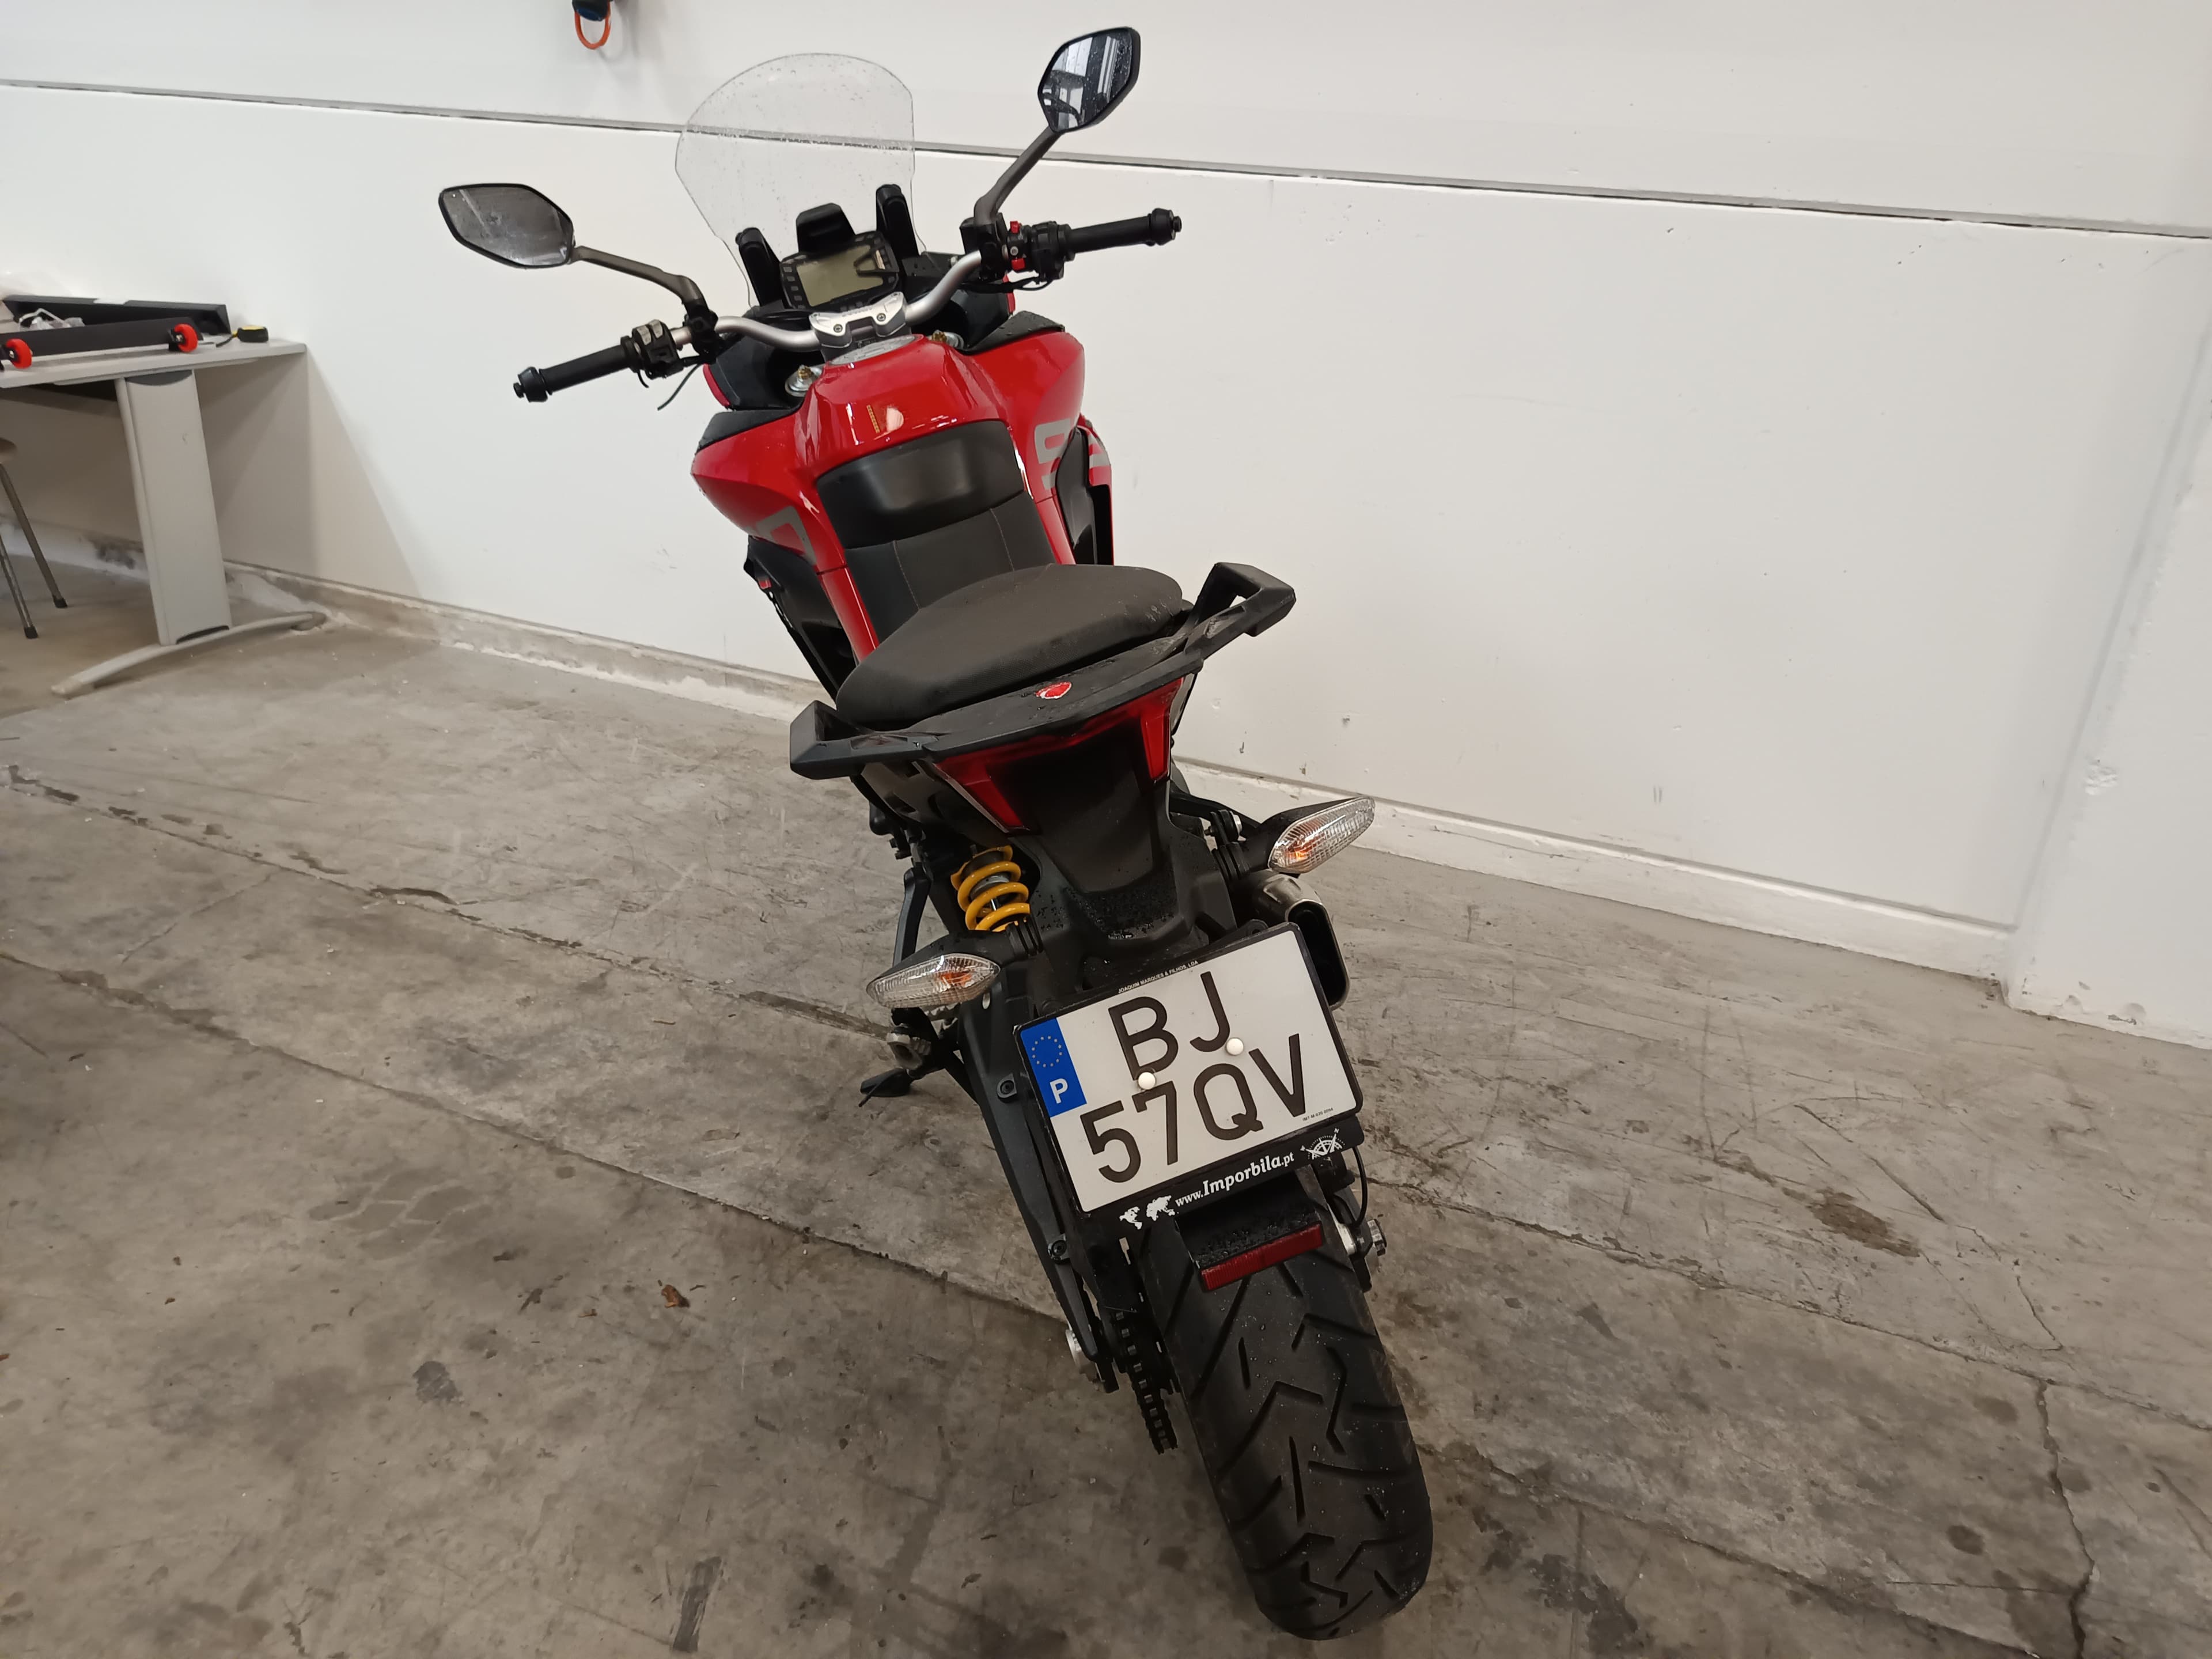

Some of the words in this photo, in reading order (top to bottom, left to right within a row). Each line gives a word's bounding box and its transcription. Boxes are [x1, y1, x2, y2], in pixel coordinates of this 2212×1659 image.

[1118, 982, 1140, 994] JOAQUIM
[1140, 972, 1164, 985] MARQUES
[1188, 960, 1199, 968] LDA
[1108, 971, 1230, 1081] BJ
[1049, 1078, 1069, 1104] P
[1080, 1033, 1306, 1183] 57QV
[1175, 1152, 1295, 1207] www.Imporbila.pt
